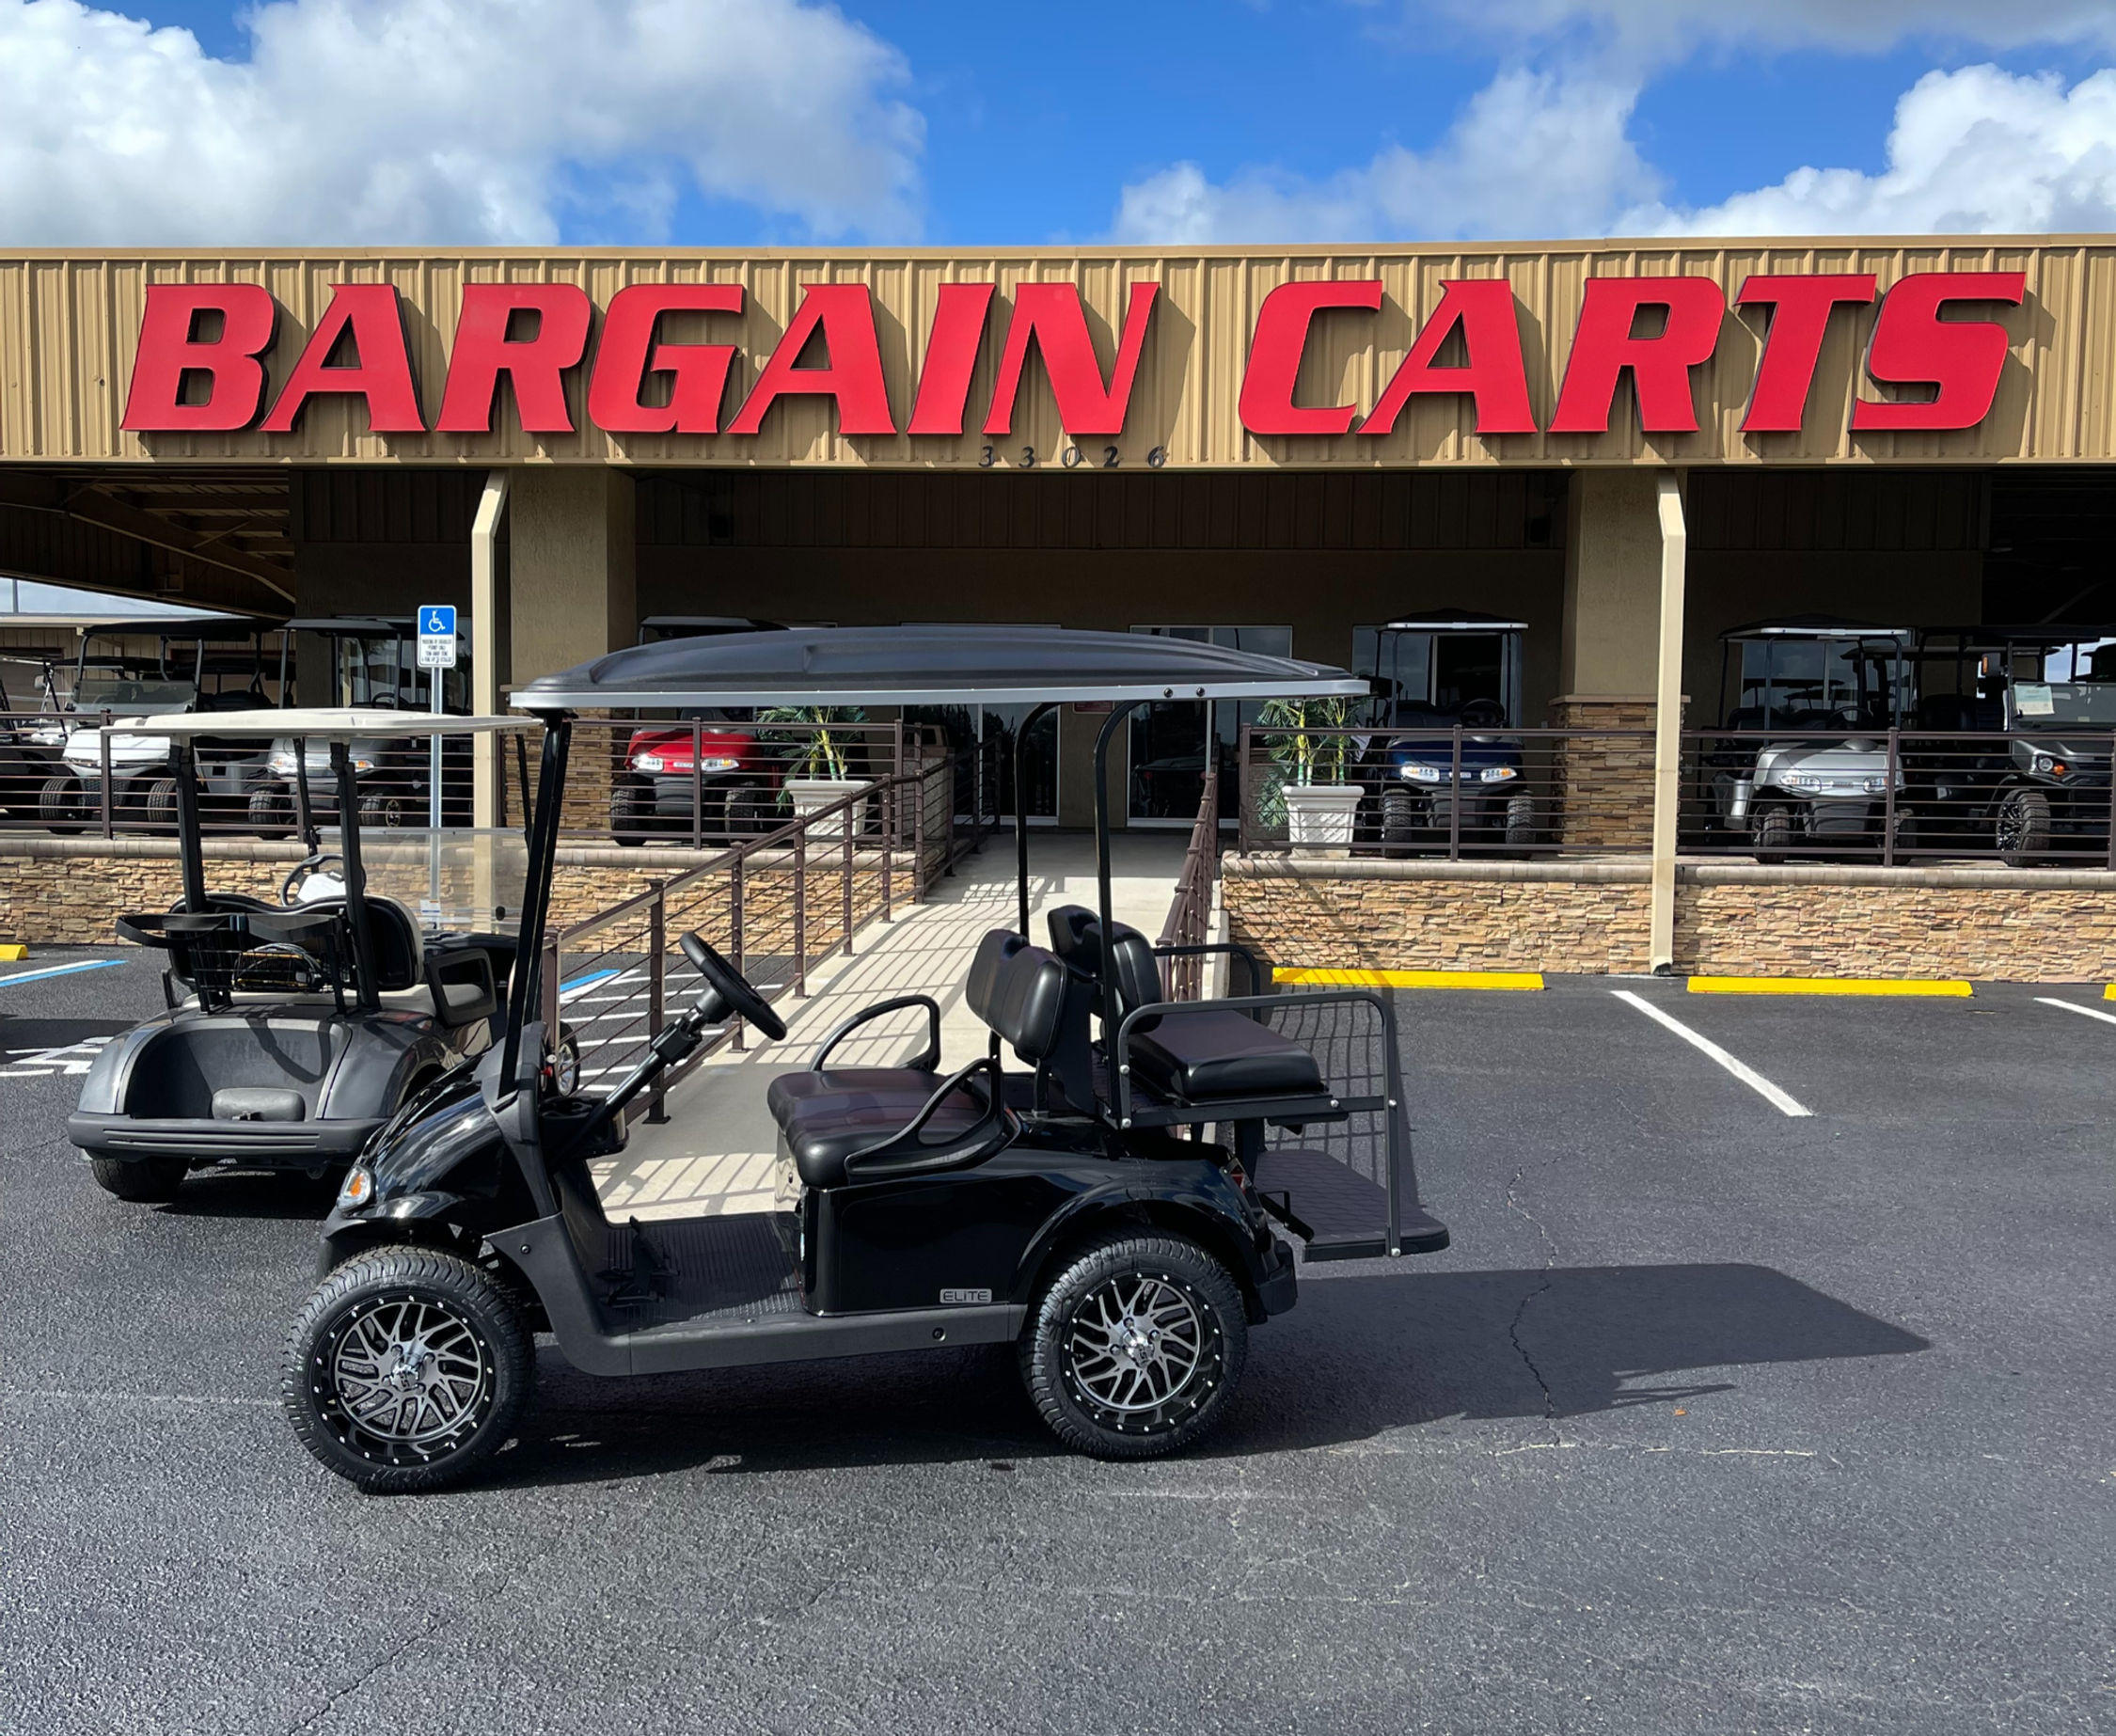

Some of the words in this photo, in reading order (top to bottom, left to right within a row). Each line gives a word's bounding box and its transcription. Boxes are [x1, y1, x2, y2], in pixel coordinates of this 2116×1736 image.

[120, 282, 1161, 436] BARGAIN
[1239, 272, 2028, 435] CARTS
[978, 446, 1165, 468] 33026
[942, 1290, 988, 1302] ELITE
